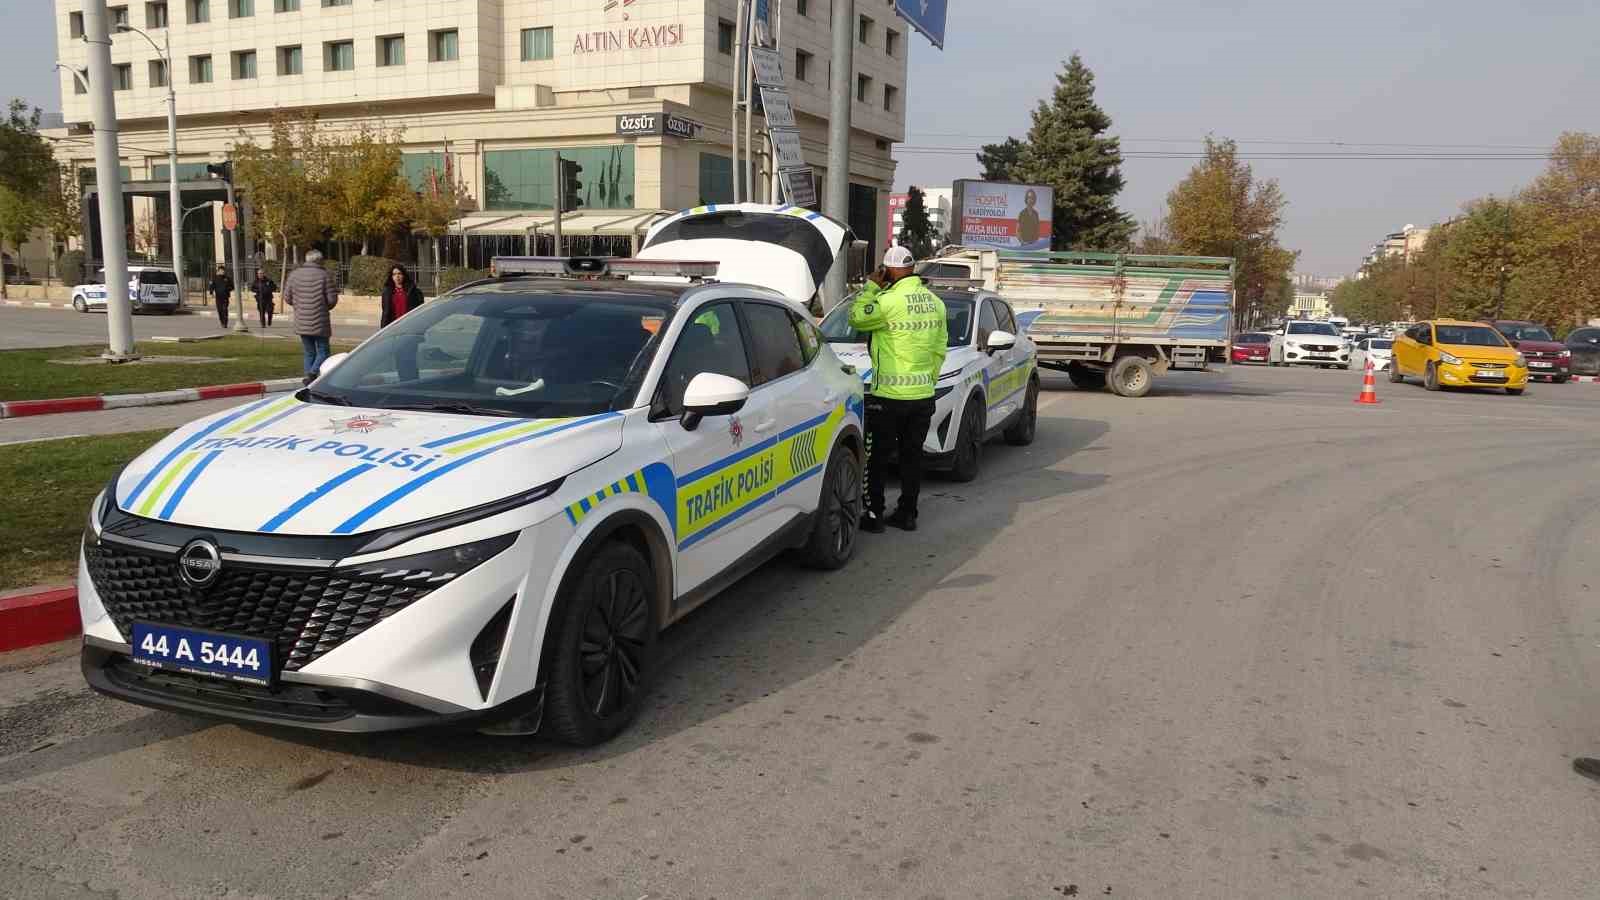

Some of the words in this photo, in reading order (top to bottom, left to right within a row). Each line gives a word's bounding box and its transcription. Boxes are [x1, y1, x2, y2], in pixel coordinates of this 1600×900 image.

[573, 29, 622, 54] ALTIN
[628, 24, 684, 48] KAYISI
[620, 115, 655, 130] ÖZSÜT
[667, 118, 692, 134] ÖZSÜT
[965, 223, 986, 235] MUSA
[193, 434, 315, 451] TRAFİK
[309, 440, 442, 472] POLİSİ
[686, 476, 735, 525] TRAFİK
[737, 452, 774, 498] POLİSİ
[141, 633, 170, 657] 44
[175, 638, 194, 662] A
[200, 641, 261, 671] 5444
